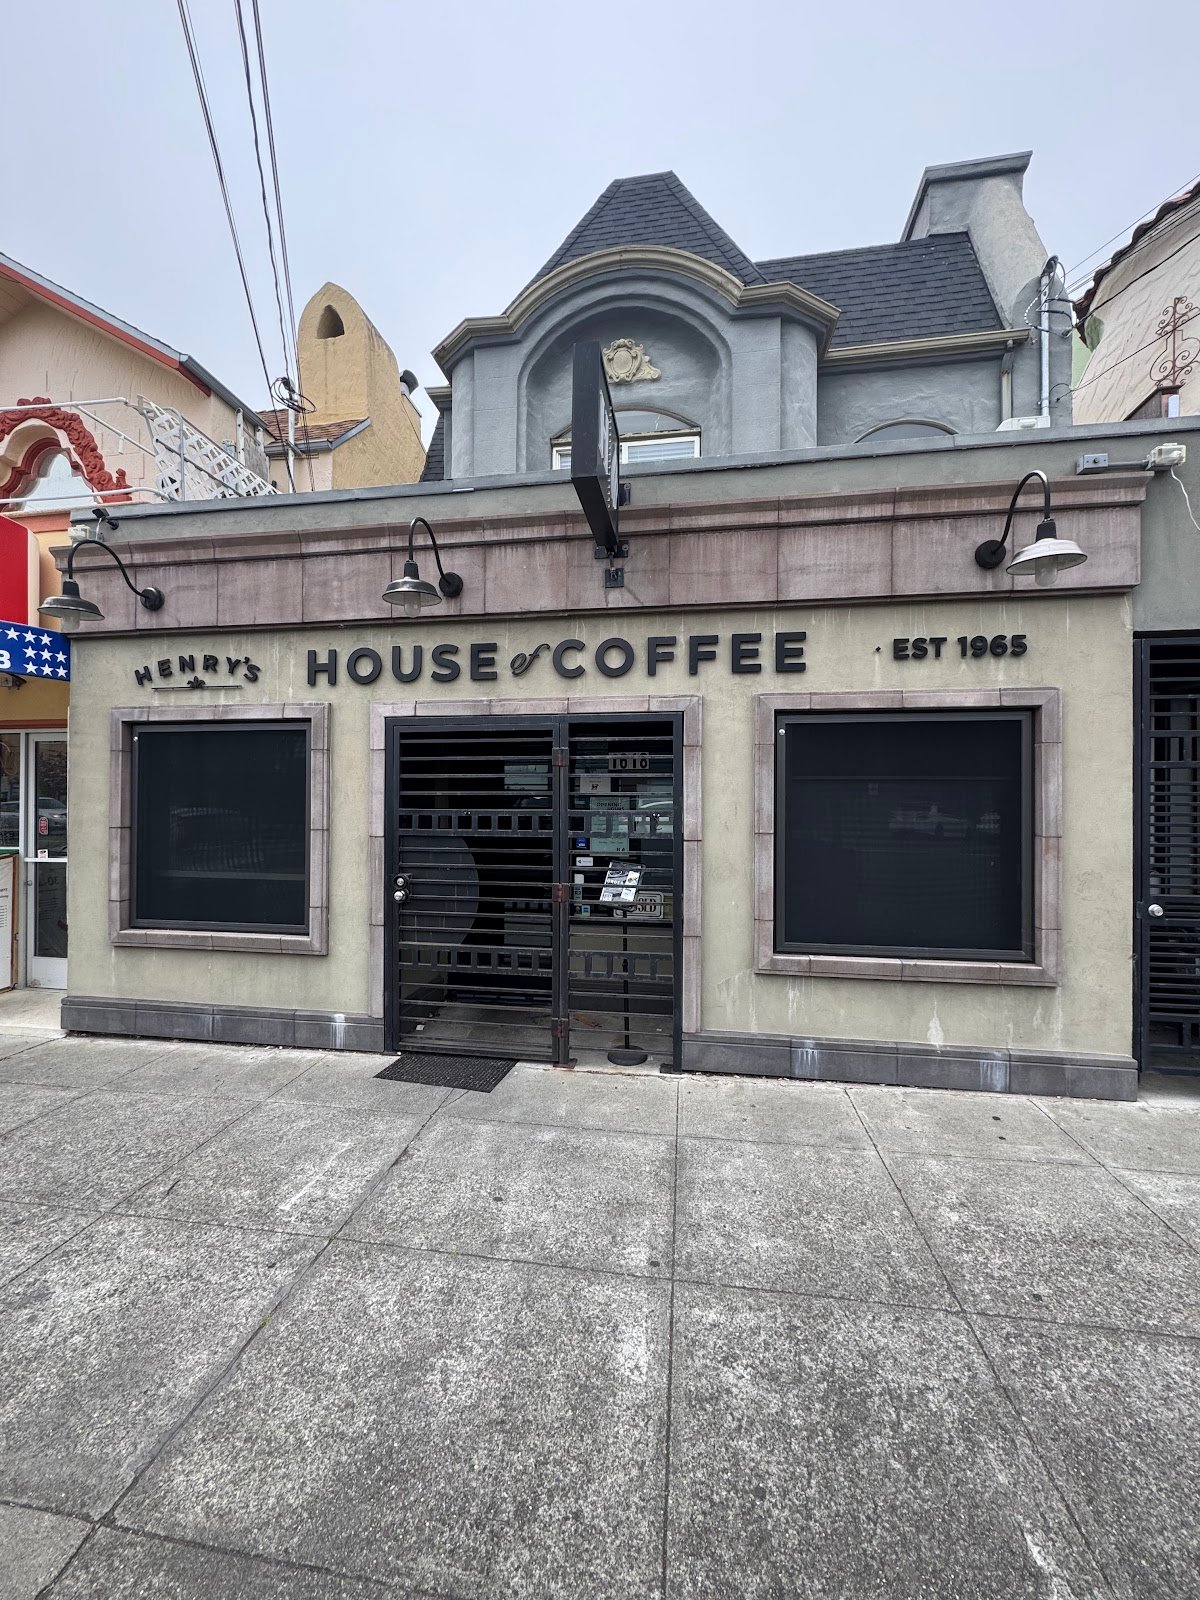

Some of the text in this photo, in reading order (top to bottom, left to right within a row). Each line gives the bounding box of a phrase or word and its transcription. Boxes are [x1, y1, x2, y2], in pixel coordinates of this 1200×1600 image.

[307, 632, 807, 686] HOUSE of COFFEE
[893, 635, 1028, 660] EST 1965
[134, 655, 261, 686] HENRY'S
